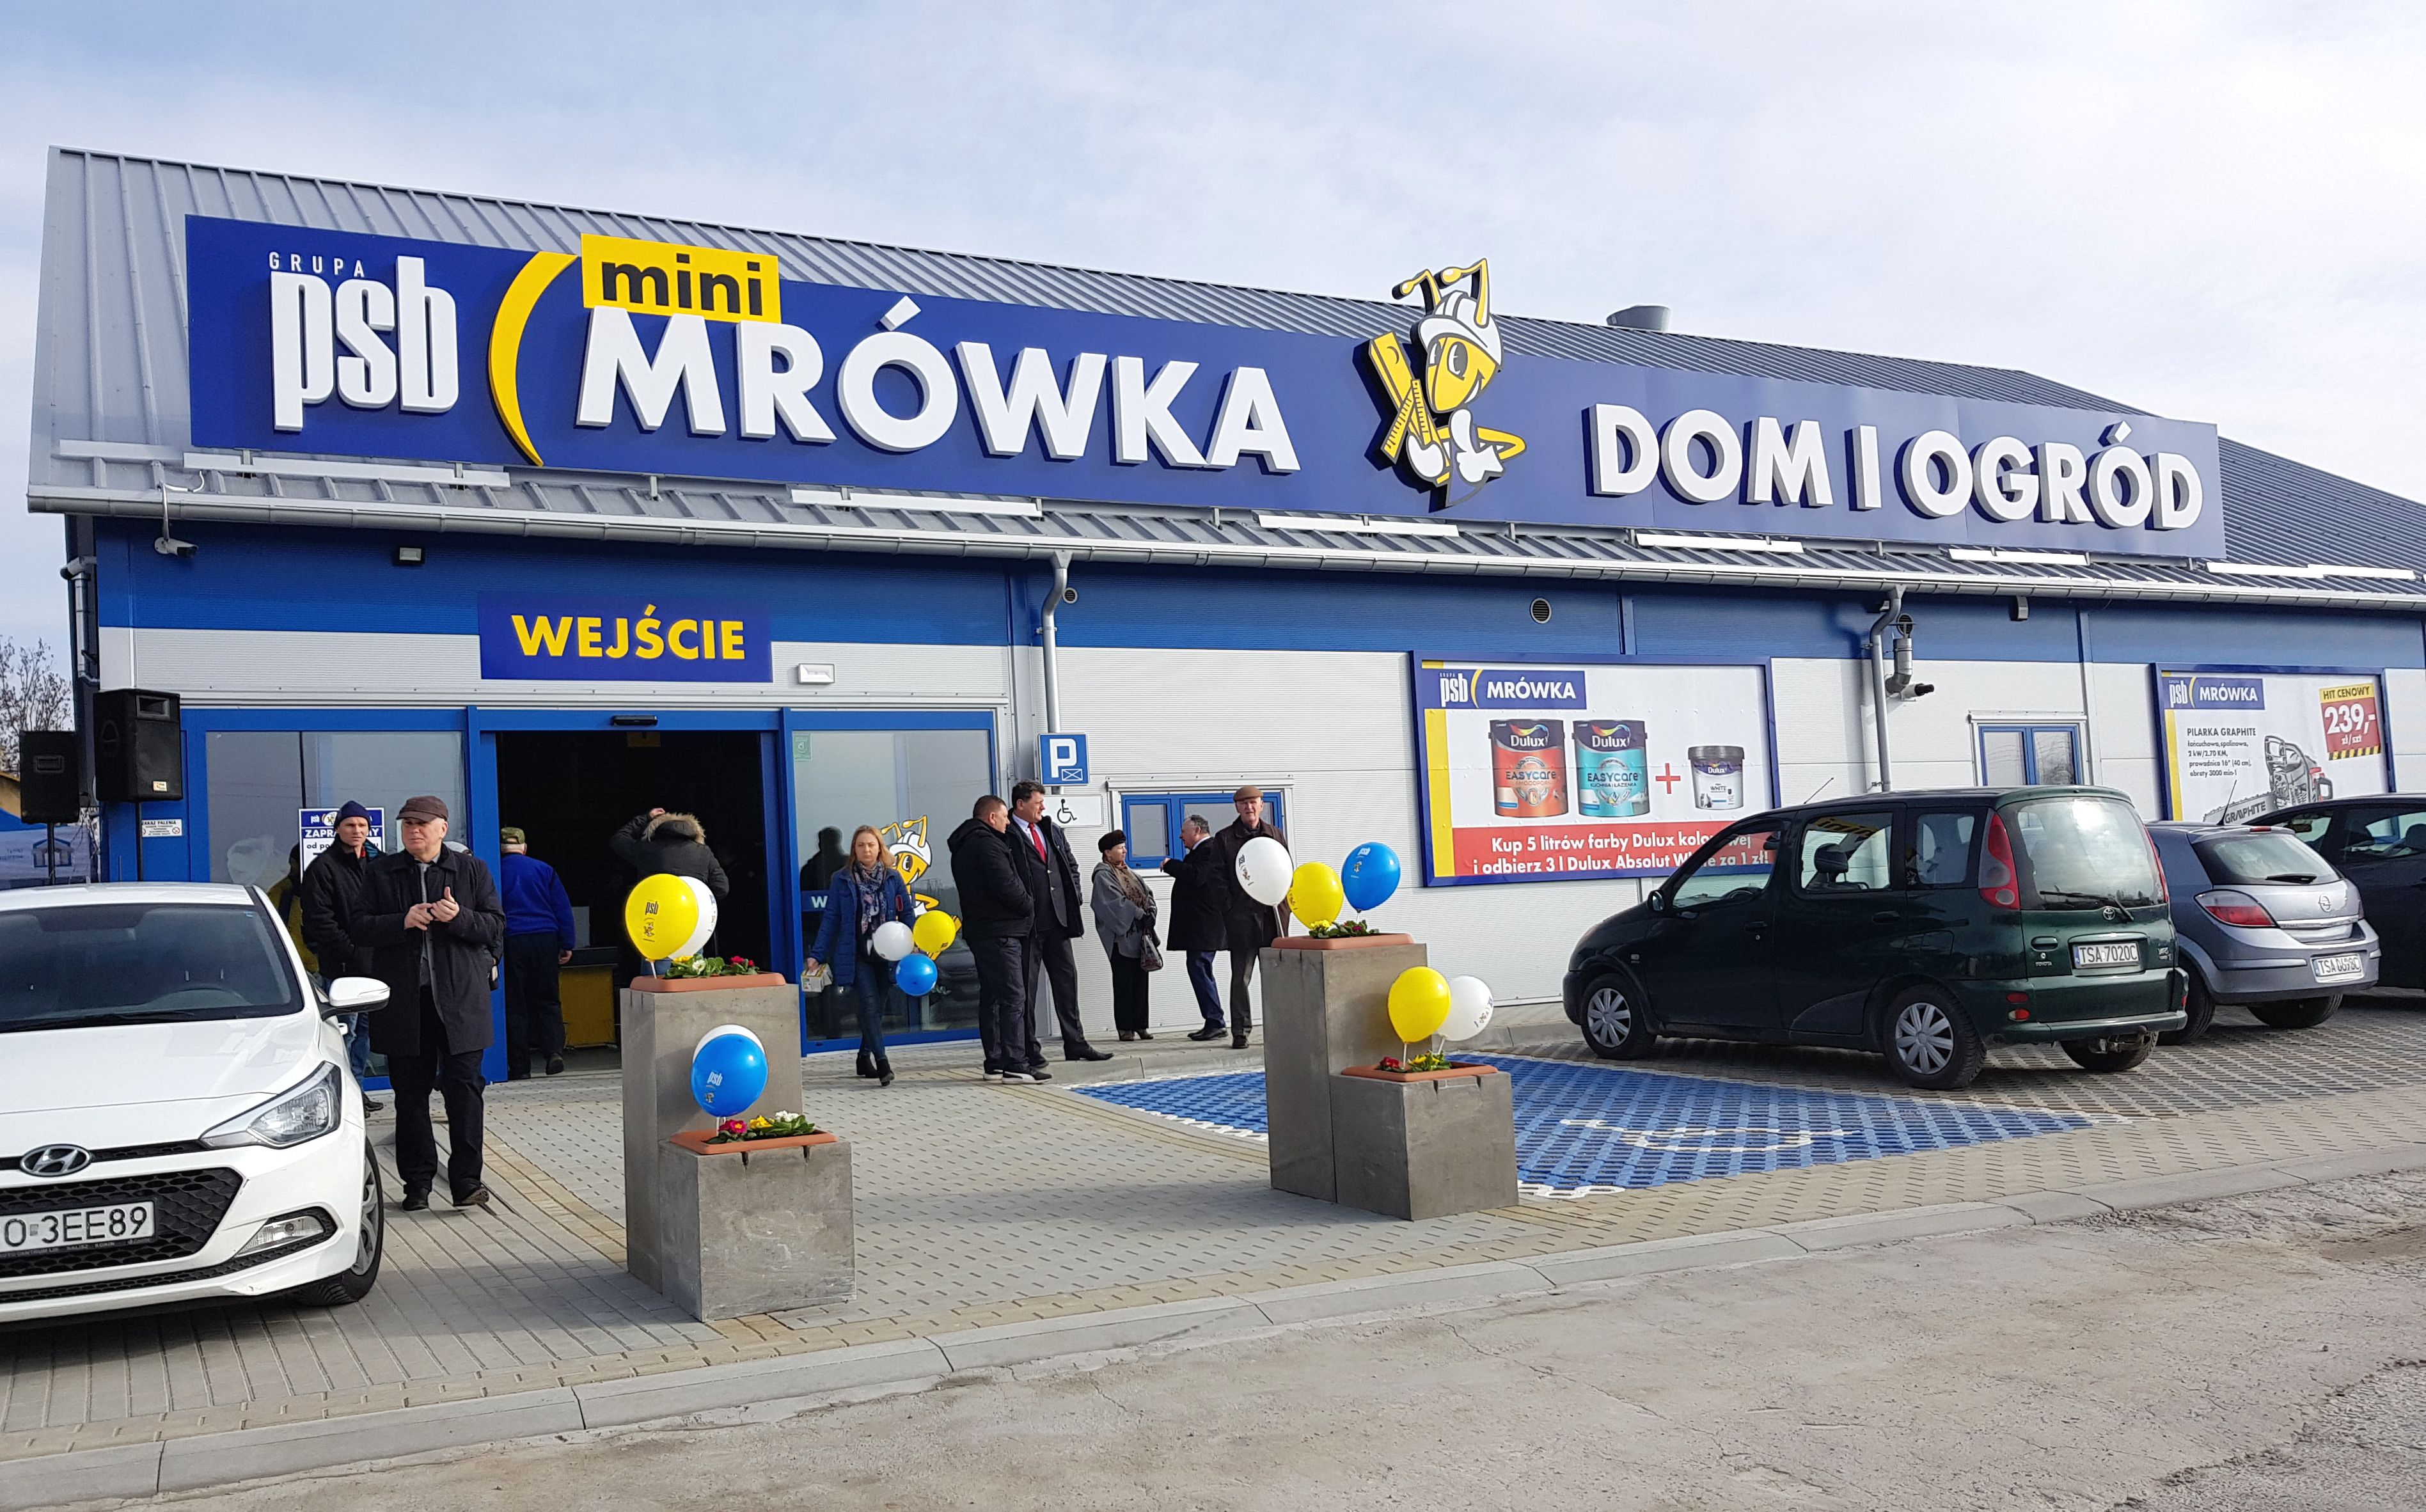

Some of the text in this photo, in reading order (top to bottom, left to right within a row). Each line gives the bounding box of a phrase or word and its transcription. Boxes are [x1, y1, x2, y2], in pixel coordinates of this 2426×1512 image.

[269, 252, 365, 278] GRUPA
[601, 253, 763, 316] mini
[271, 256, 459, 432] psb
[575, 295, 1301, 475] MRÓWKA
[1591, 403, 2203, 530] DOM I OGRÓD
[511, 604, 745, 659] WEJŚCIE
[1440, 673, 1469, 707] psb
[1486, 676, 1577, 699] MRÓWKA
[2168, 680, 2188, 709] psb
[2200, 682, 2258, 702] MRÓWKA
[2323, 686, 2370, 700] HIT CENOWY
[1511, 735, 1545, 747] Dulux
[1591, 736, 1627, 748] Dulux
[2187, 727, 2256, 736] PILARKA GRAPHITE
[1050, 739, 1077, 778] P
[2225, 801, 2266, 824] GRAPHITE
[1492, 837, 1523, 856] Kup
[1527, 836, 1536, 851] 5
[1540, 835, 1584, 851] litrów
[1588, 833, 1628, 852] farby
[1632, 831, 1675, 848] Dulux
[1473, 859, 1478, 874] i
[1482, 858, 1542, 874] odbierz
[1545, 856, 1556, 872] 3
[1567, 854, 1611, 870] Dulux
[1615, 853, 1670, 869] Absolut
[1719, 855, 1737, 866] za
[1741, 852, 1747, 865] 1
[1752, 849, 1768, 864] zł!
[645, 901, 659, 916] psb
[2079, 945, 2102, 963] TSA
[2106, 945, 2138, 962] 7020C
[2318, 959, 2336, 974] TSA
[707, 1070, 723, 1086] psb
[40, 1206, 148, 1244] 3EE89
